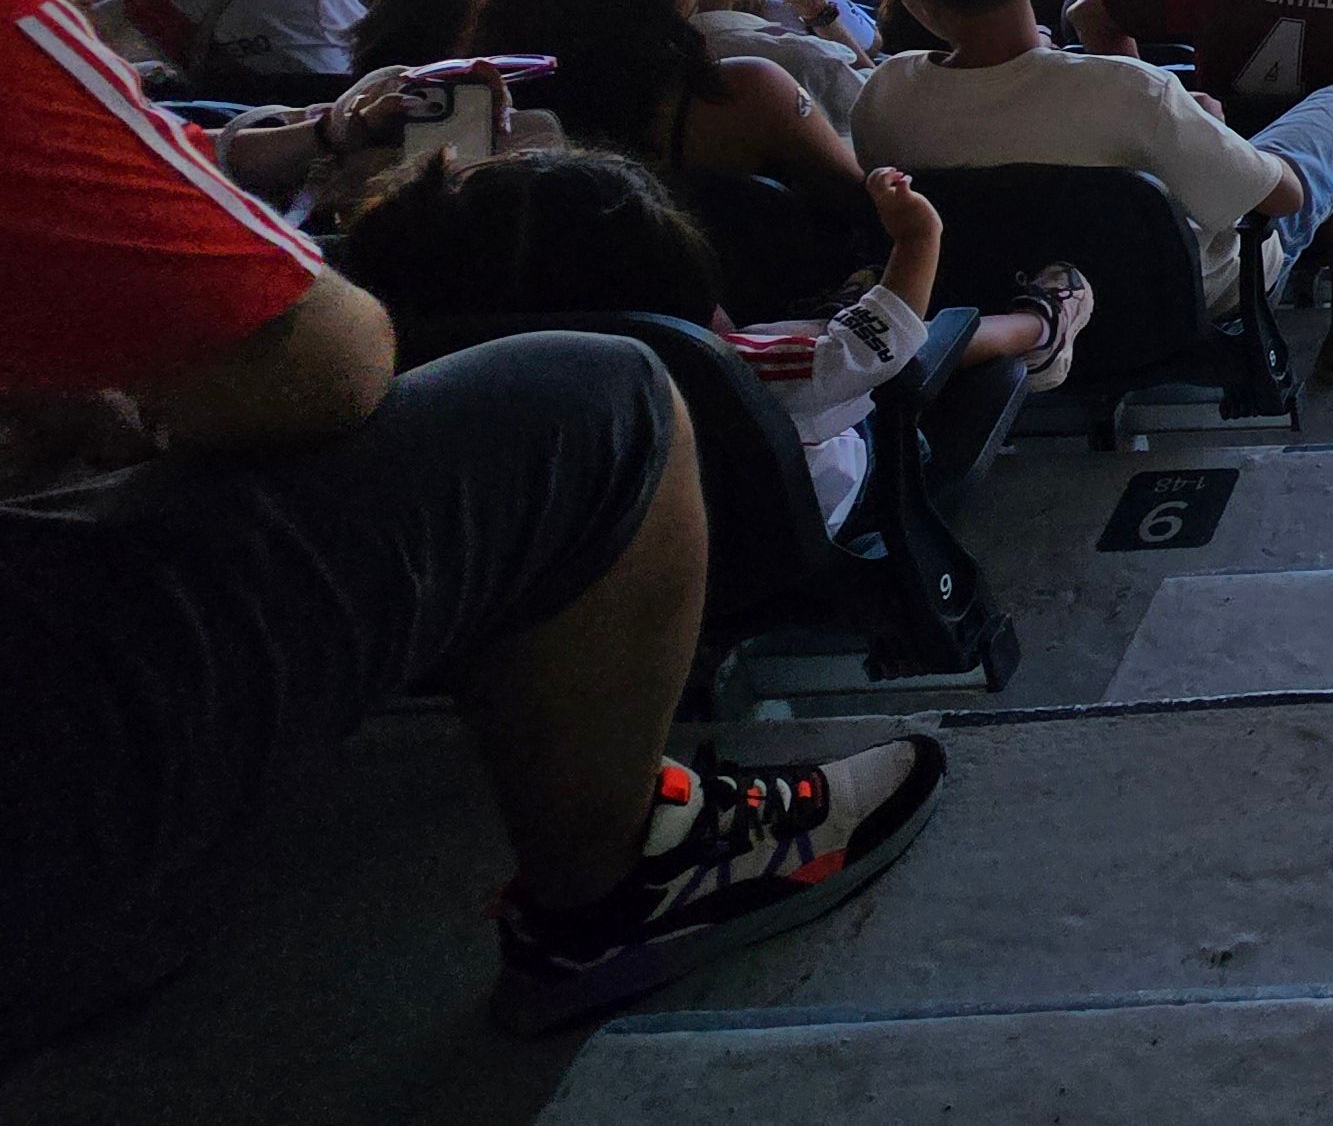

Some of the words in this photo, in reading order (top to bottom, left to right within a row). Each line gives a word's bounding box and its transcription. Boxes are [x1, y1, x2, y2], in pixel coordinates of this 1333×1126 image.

[1231, 16, 1306, 96] 4
[850, 306, 889, 334] CAR
[939, 572, 953, 601] 9
